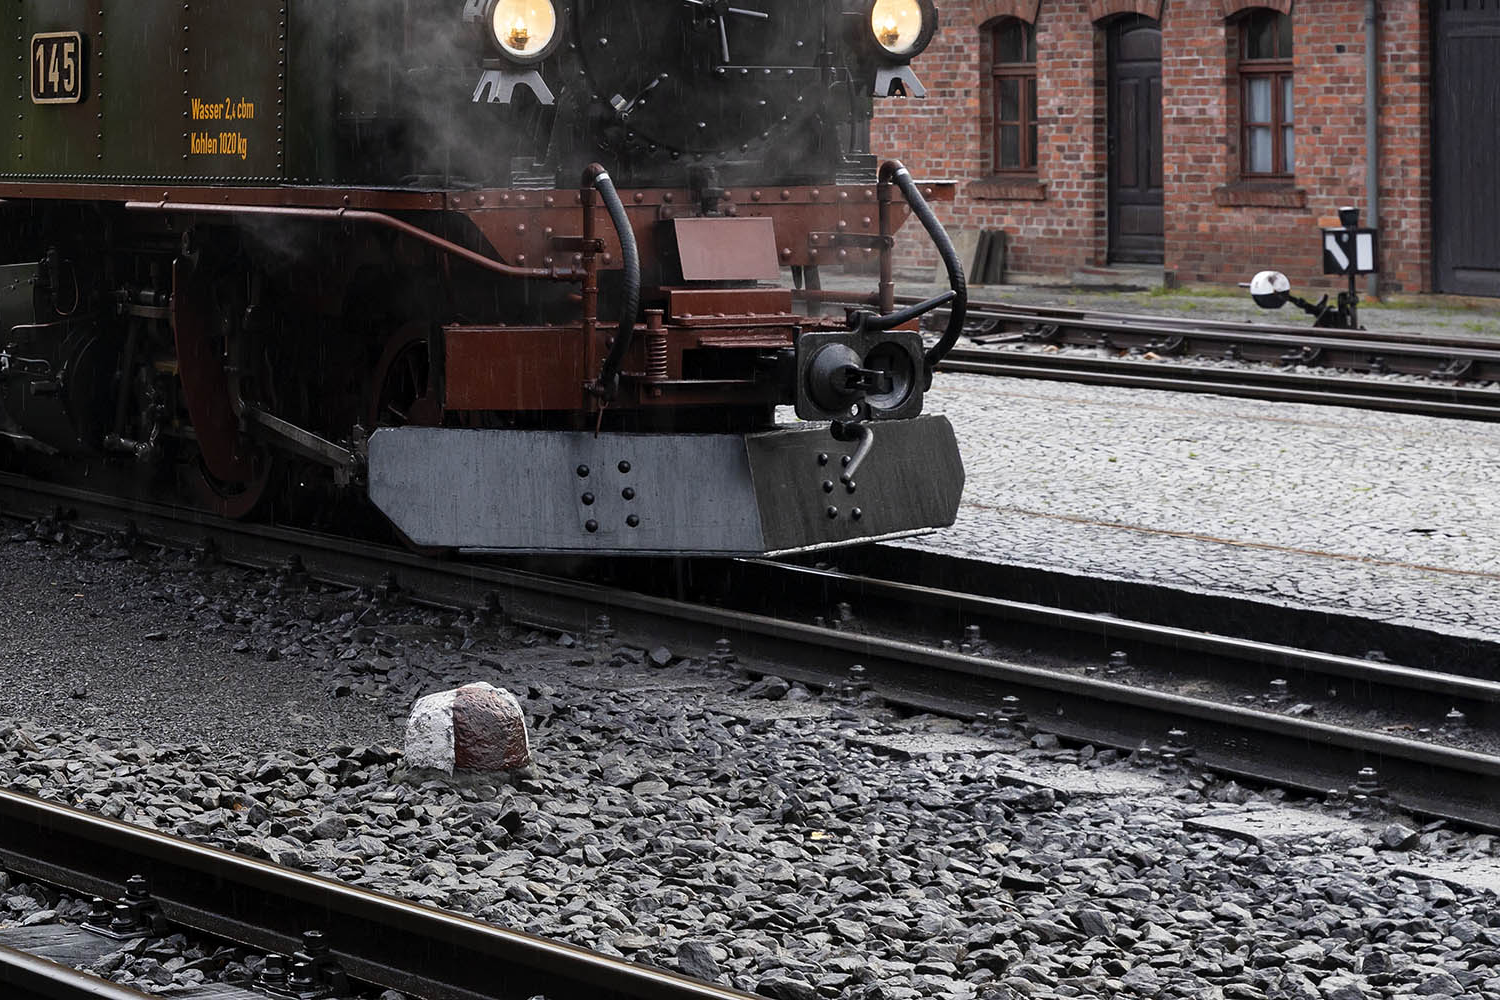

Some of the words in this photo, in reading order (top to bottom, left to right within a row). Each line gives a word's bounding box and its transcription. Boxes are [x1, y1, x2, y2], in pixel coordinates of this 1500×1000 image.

[35, 42, 75, 94] 145
[191, 98, 224, 120] Wasser
[237, 96, 254, 119] cbm
[191, 131, 218, 154] Kohlen
[219, 131, 237, 154] 1020
[237, 131, 247, 160] kg
